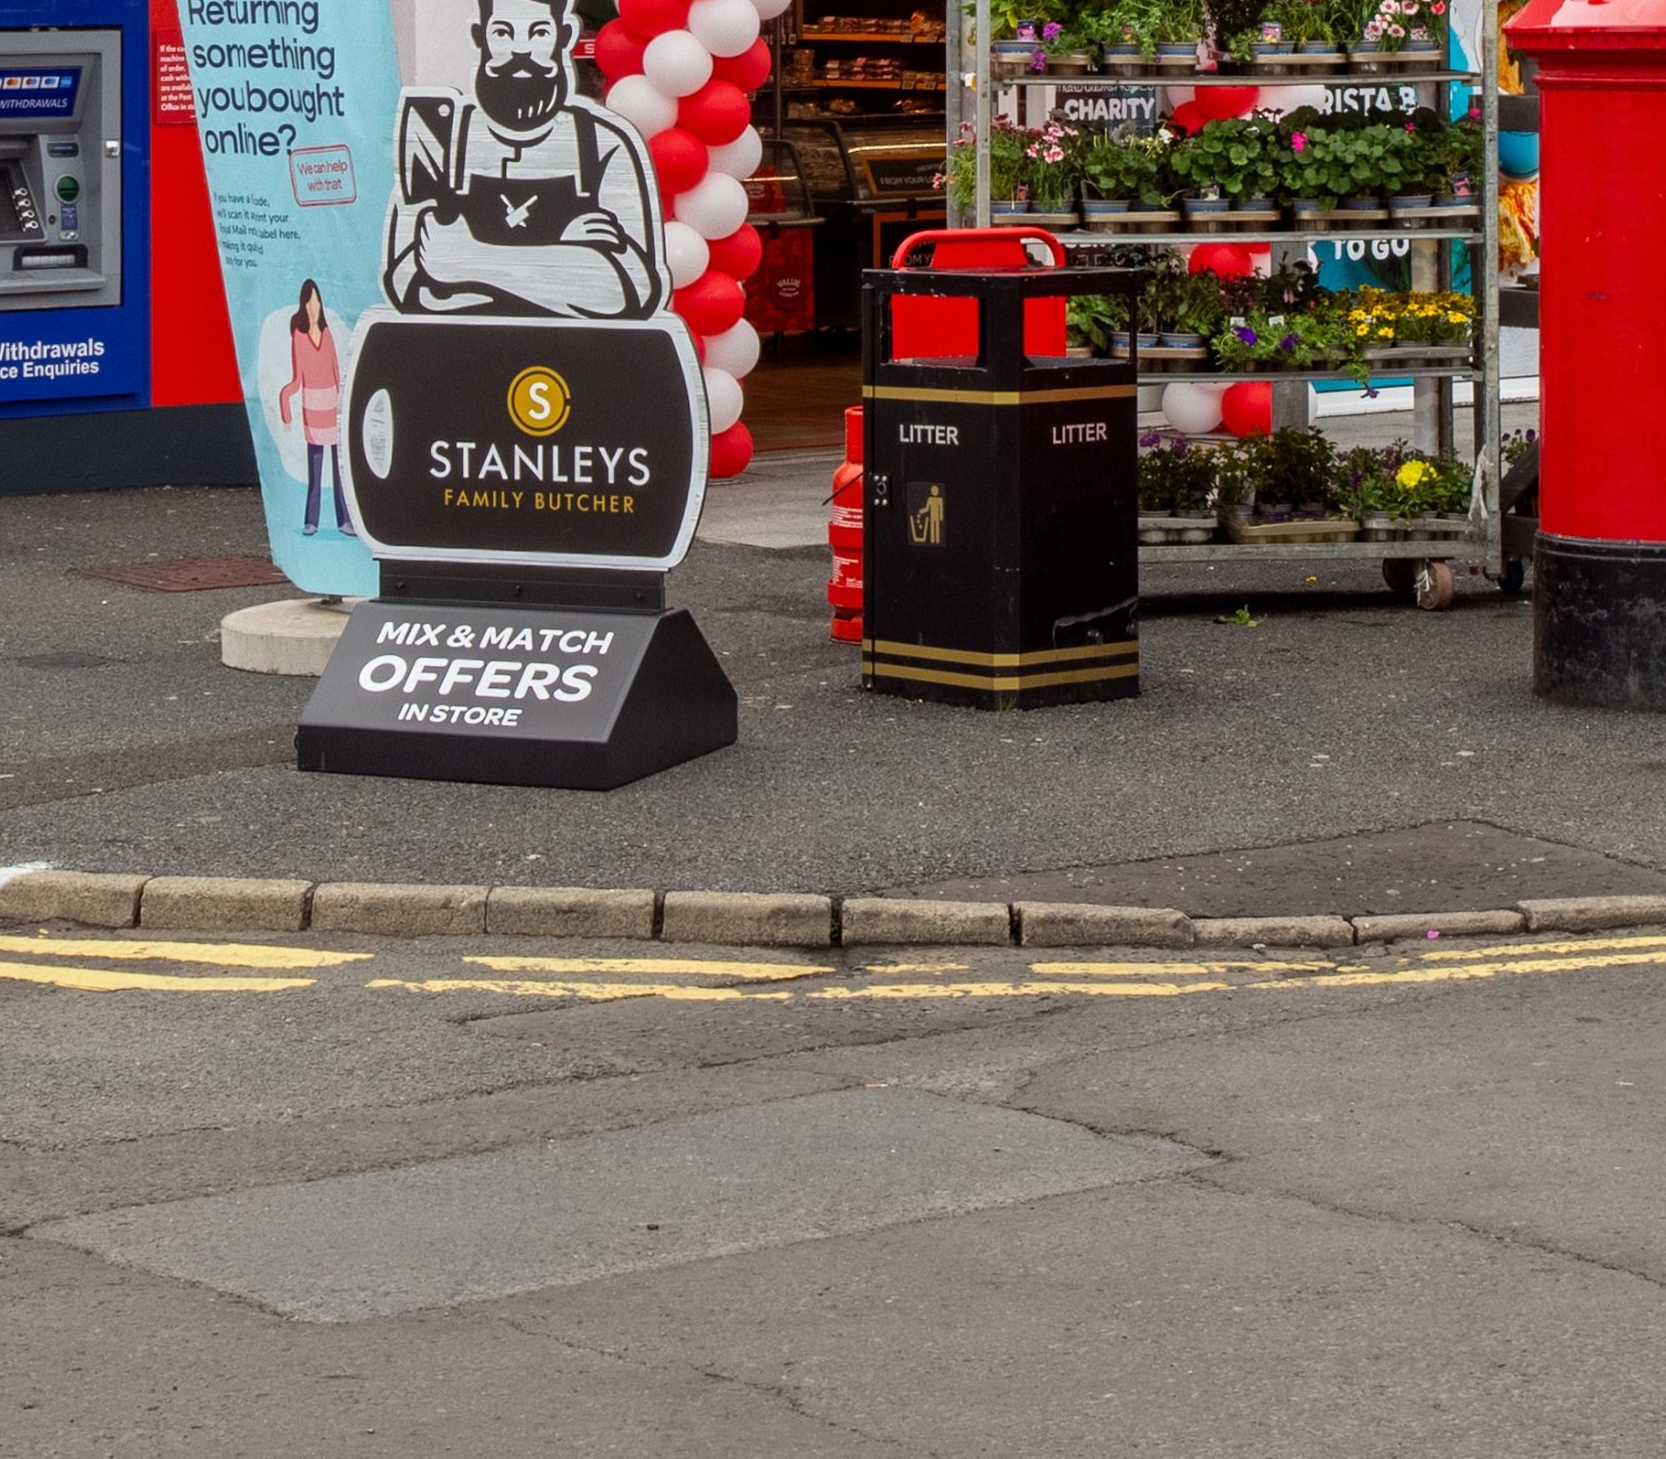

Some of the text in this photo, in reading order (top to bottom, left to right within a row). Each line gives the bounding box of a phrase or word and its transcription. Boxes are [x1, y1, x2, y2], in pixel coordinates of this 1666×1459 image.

[193, 36, 335, 80] something
[1063, 97, 1155, 121] CHARITY
[1323, 87, 1393, 116] RISTA
[205, 122, 297, 156] online?
[1332, 239, 1410, 261] TO GO
[23, 359, 100, 379] Enquiries
[528, 382, 551, 421] S
[899, 424, 960, 446] LITTER
[1052, 422, 1108, 445] LITTER
[429, 441, 650, 486] STANLEYS
[444, 488, 634, 514] FAMILY BUTCHER
[376, 621, 614, 655] MIX & MATCH
[358, 654, 599, 703] OFFERS
[397, 703, 523, 727] IN STORE
